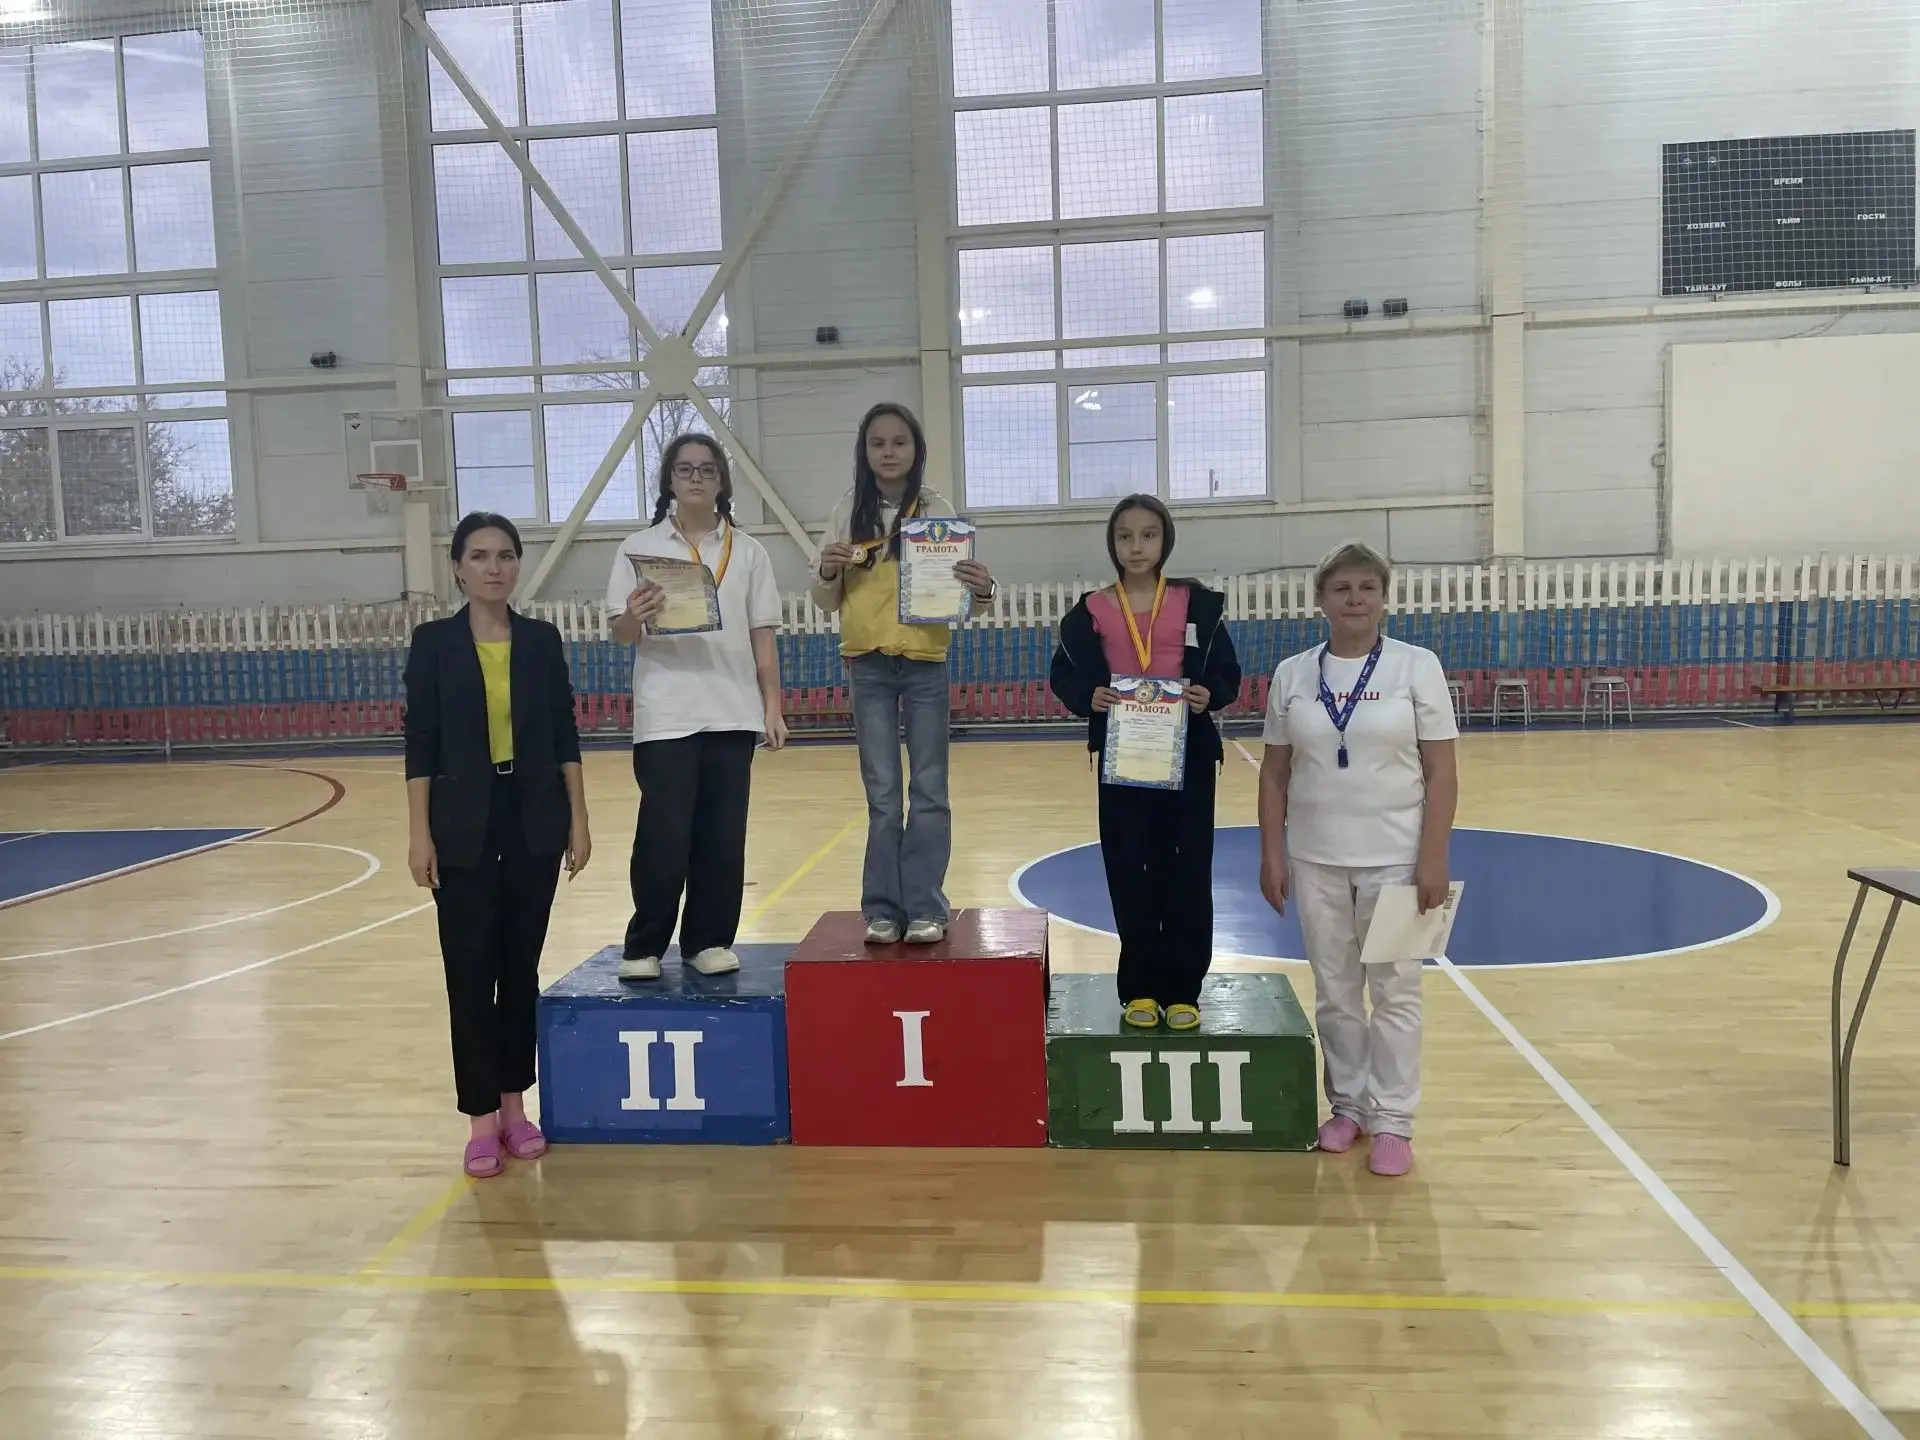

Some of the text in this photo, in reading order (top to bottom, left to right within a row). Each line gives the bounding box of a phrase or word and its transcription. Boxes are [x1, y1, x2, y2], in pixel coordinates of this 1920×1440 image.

[1774, 177, 1803, 186] ВРЕМЯ
[1776, 216, 1801, 225] ТАЙМ
[1686, 221, 1726, 230] ХОЗЯЕВА
[1775, 280, 1802, 288] ФОЛЫ
[1850, 275, 1892, 284] ТАЙМ-АУТ
[1685, 283, 1727, 292] ТАЙМ-АУТ
[915, 545, 958, 554] ГРАМОТА
[1125, 703, 1171, 715] ГРАМОТА
[892, 1010, 935, 1088] I
[618, 1030, 706, 1111] II
[1110, 1050, 1254, 1134] III
